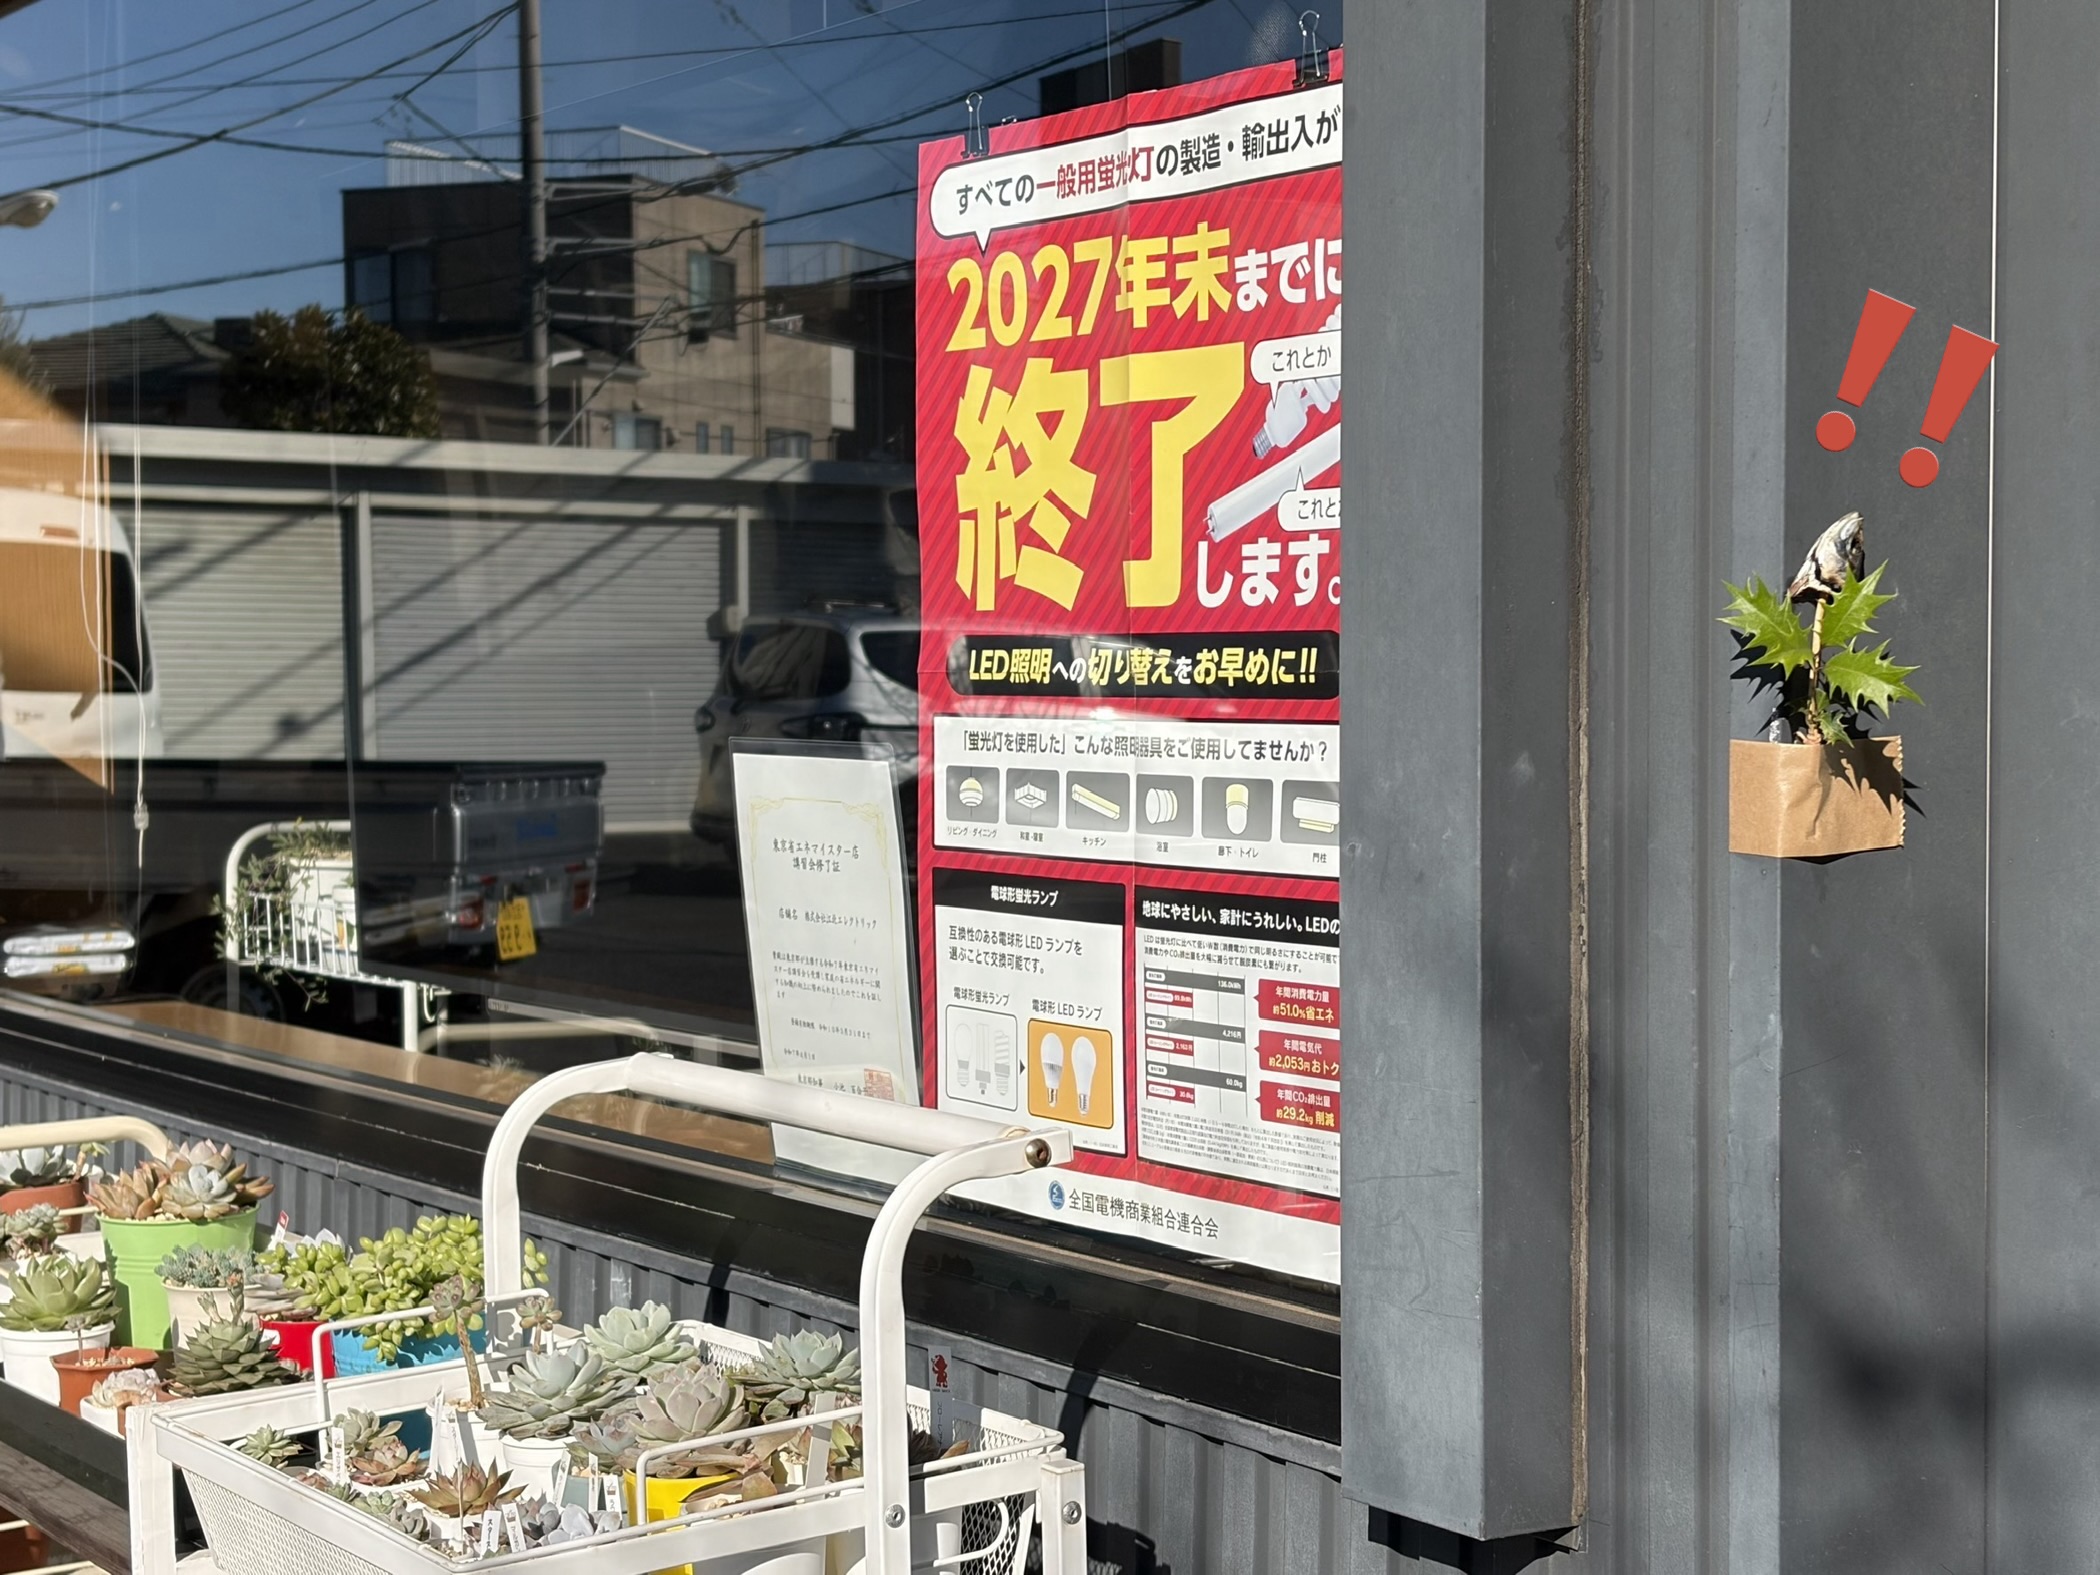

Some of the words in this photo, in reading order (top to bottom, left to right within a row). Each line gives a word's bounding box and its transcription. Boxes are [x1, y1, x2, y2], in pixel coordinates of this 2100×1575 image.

[1272, 344, 1332, 372] これとか
[953, 341, 1245, 611] 終了
[1298, 497, 1340, 519] これと
[1082, 836, 1106, 847] キッチン
[1068, 1187, 1219, 1240] 全国電機商業組合連合会
